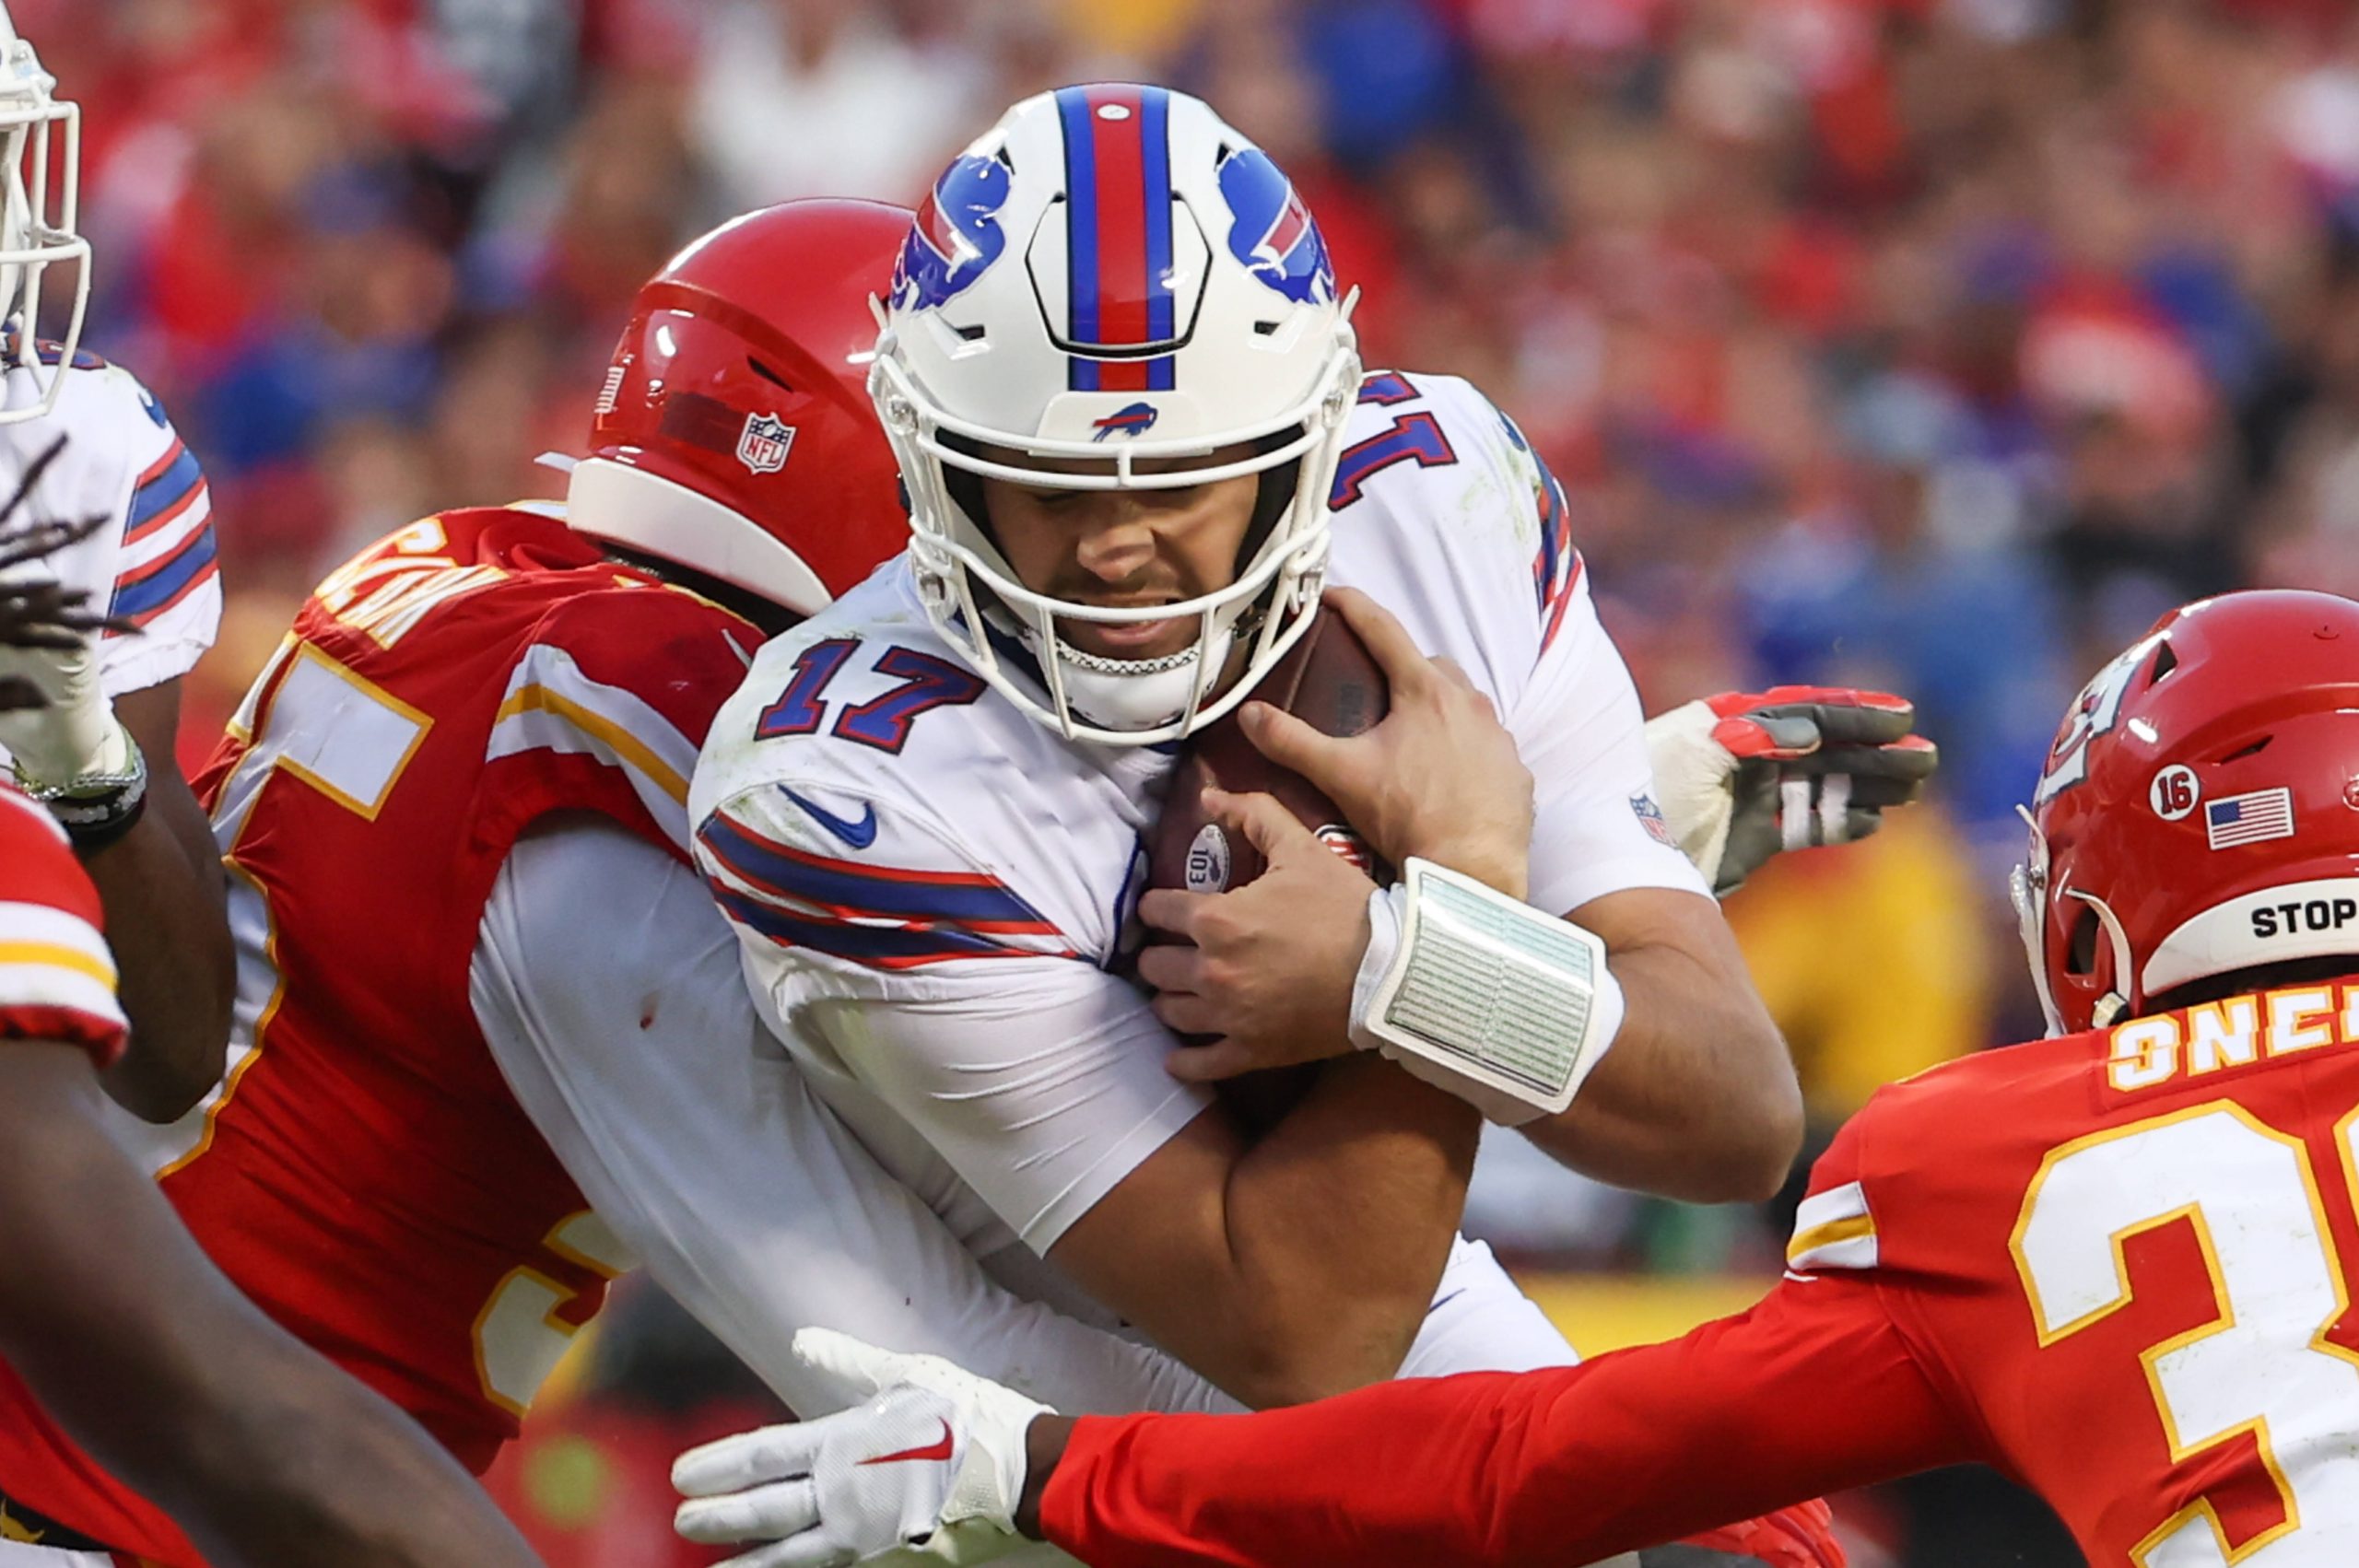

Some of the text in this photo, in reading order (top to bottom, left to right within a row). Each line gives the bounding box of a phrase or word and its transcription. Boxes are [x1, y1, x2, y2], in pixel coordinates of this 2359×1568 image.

[745, 435, 781, 464] NFL
[754, 638, 988, 755] 17
[2157, 770, 2192, 815] 16
[1189, 848, 1210, 884] 103
[2251, 898, 2357, 938] STOP
[2107, 985, 2359, 1093] SNE
[2008, 1097, 2359, 1568] 3
